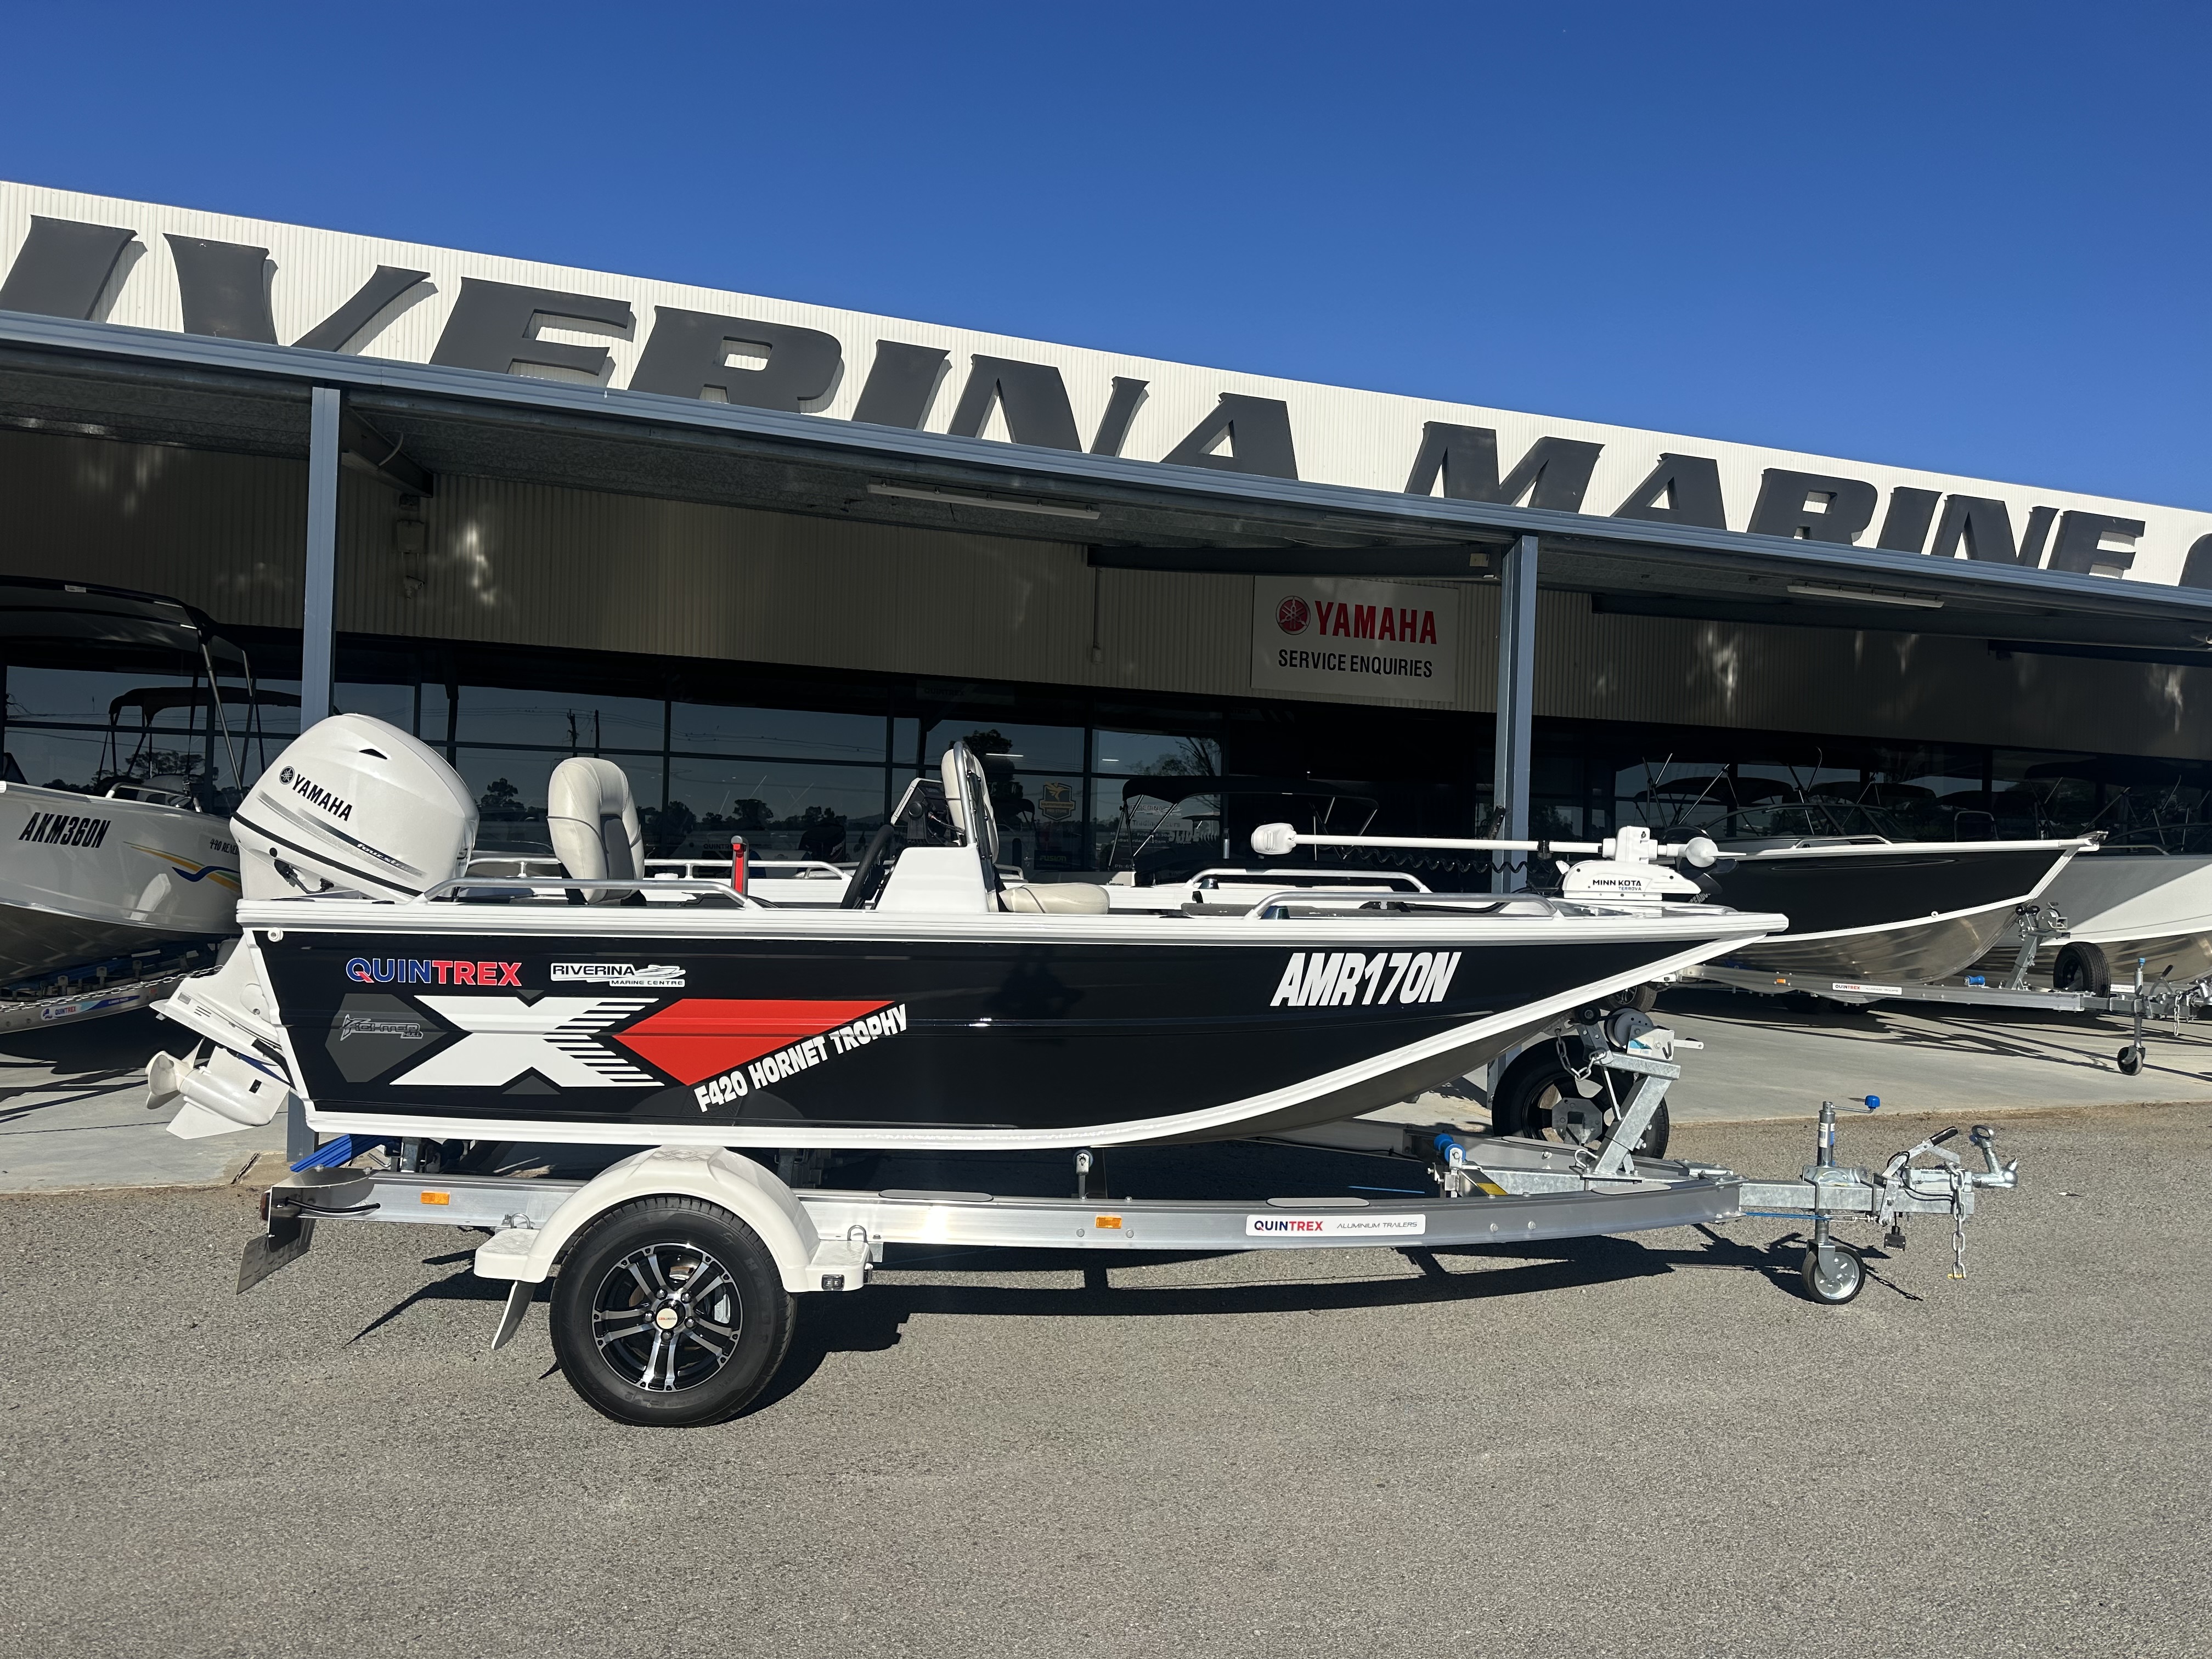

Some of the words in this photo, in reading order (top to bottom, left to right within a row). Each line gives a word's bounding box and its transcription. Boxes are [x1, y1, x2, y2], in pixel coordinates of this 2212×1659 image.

[1404, 421, 2146, 576] MARINE
[1314, 601, 1437, 645] YAMAHA
[1278, 649, 1346, 672] SERVICE
[1350, 655, 1433, 678] ENQUIRIES
[292, 774, 353, 821] YAMAHA
[18, 812, 111, 848] AKM360N
[210, 838, 222, 851] 440
[346, 957, 522, 986] QUINTREX
[553, 965, 635, 975] RIVERINA
[1269, 952, 1462, 1006] AMR170N
[55, 1006, 76, 1015] QUINTREX
[694, 1070, 748, 1113] F420
[748, 1035, 828, 1090] HORNET
[828, 1003, 907, 1054] TROPHY
[1254, 1220, 1323, 1231] QUINTREX
